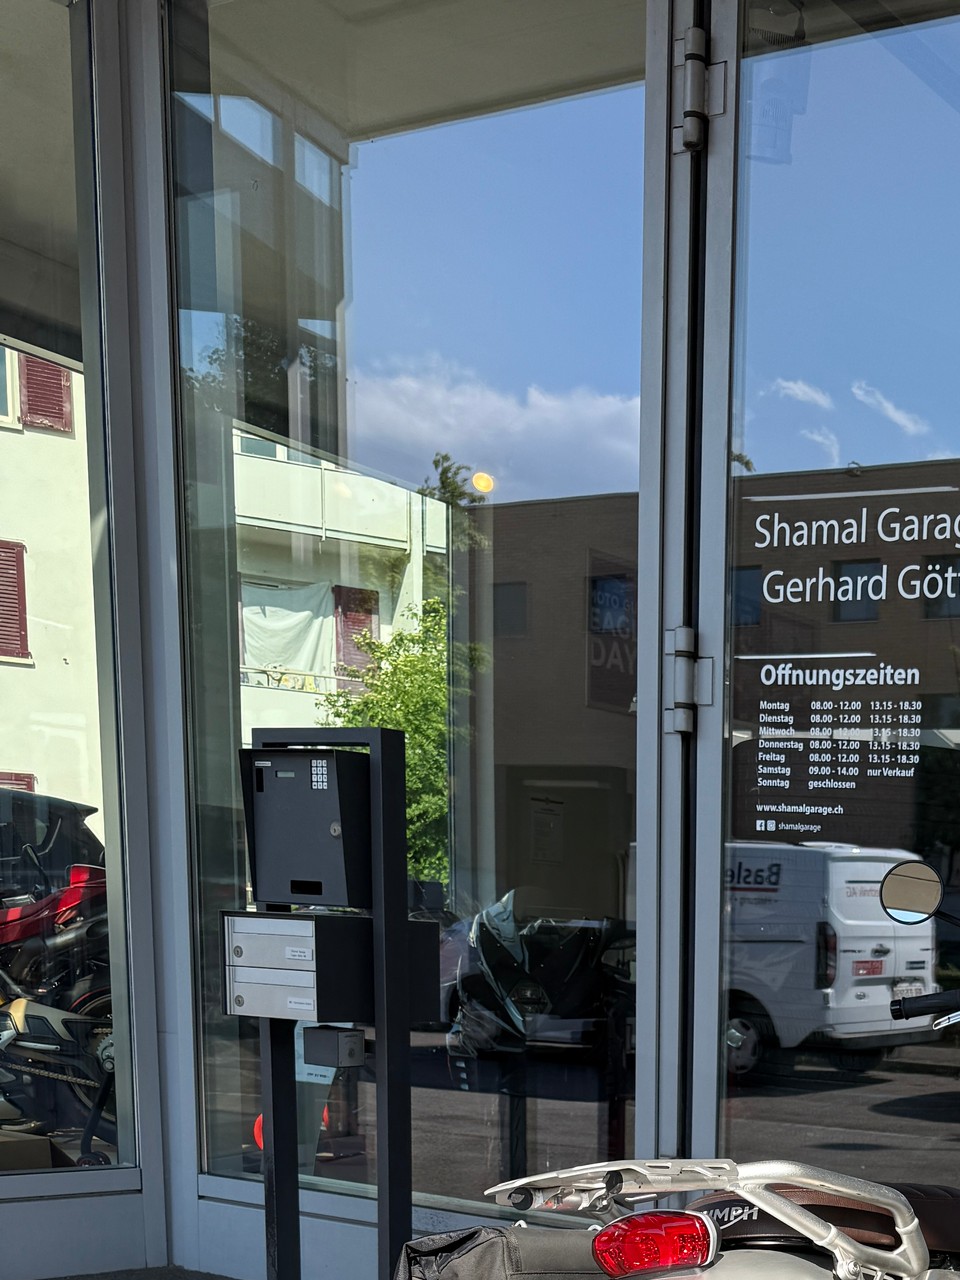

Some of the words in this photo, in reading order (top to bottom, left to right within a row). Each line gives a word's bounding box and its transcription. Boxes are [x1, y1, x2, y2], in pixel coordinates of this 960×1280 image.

[755, 508, 867, 548] Shamal
[763, 565, 887, 603] Gerhard
[760, 701, 789, 712] Montag
[811, 702, 833, 711] 08.00
[840, 702, 861, 710] 12.00
[871, 702, 892, 710] 13.15
[900, 702, 922, 710] 18.30
[760, 714, 793, 725] Dienstag
[810, 715, 832, 724] 08.00
[839, 715, 860, 724] 12.00
[870, 715, 891, 724] 13.15
[899, 715, 921, 724] 18.30
[759, 727, 795, 736] Mittwoch
[810, 728, 832, 737] 08.00
[899, 728, 920, 737] 18.30
[759, 740, 803, 752] Donnerstag
[810, 741, 831, 750] 08.00
[838, 741, 859, 750] 12.00
[869, 742, 890, 751] 13.15
[898, 742, 920, 751] 18.30
[758, 753, 785, 764] Freitag
[809, 754, 831, 763] 08.00
[838, 754, 859, 763] 12.00
[868, 755, 890, 764] 13.15
[897, 755, 919, 764] 18.30
[758, 765, 791, 777] Samstag
[809, 766, 830, 776] 09.00
[837, 767, 859, 776] 14.00
[883, 768, 914, 778] Verkauf
[758, 778, 789, 789] Sonntag
[808, 779, 855, 790] geschlossen
[756, 803, 843, 815] www.shamalgarage.ch
[779, 822, 821, 834] shamalgarage
